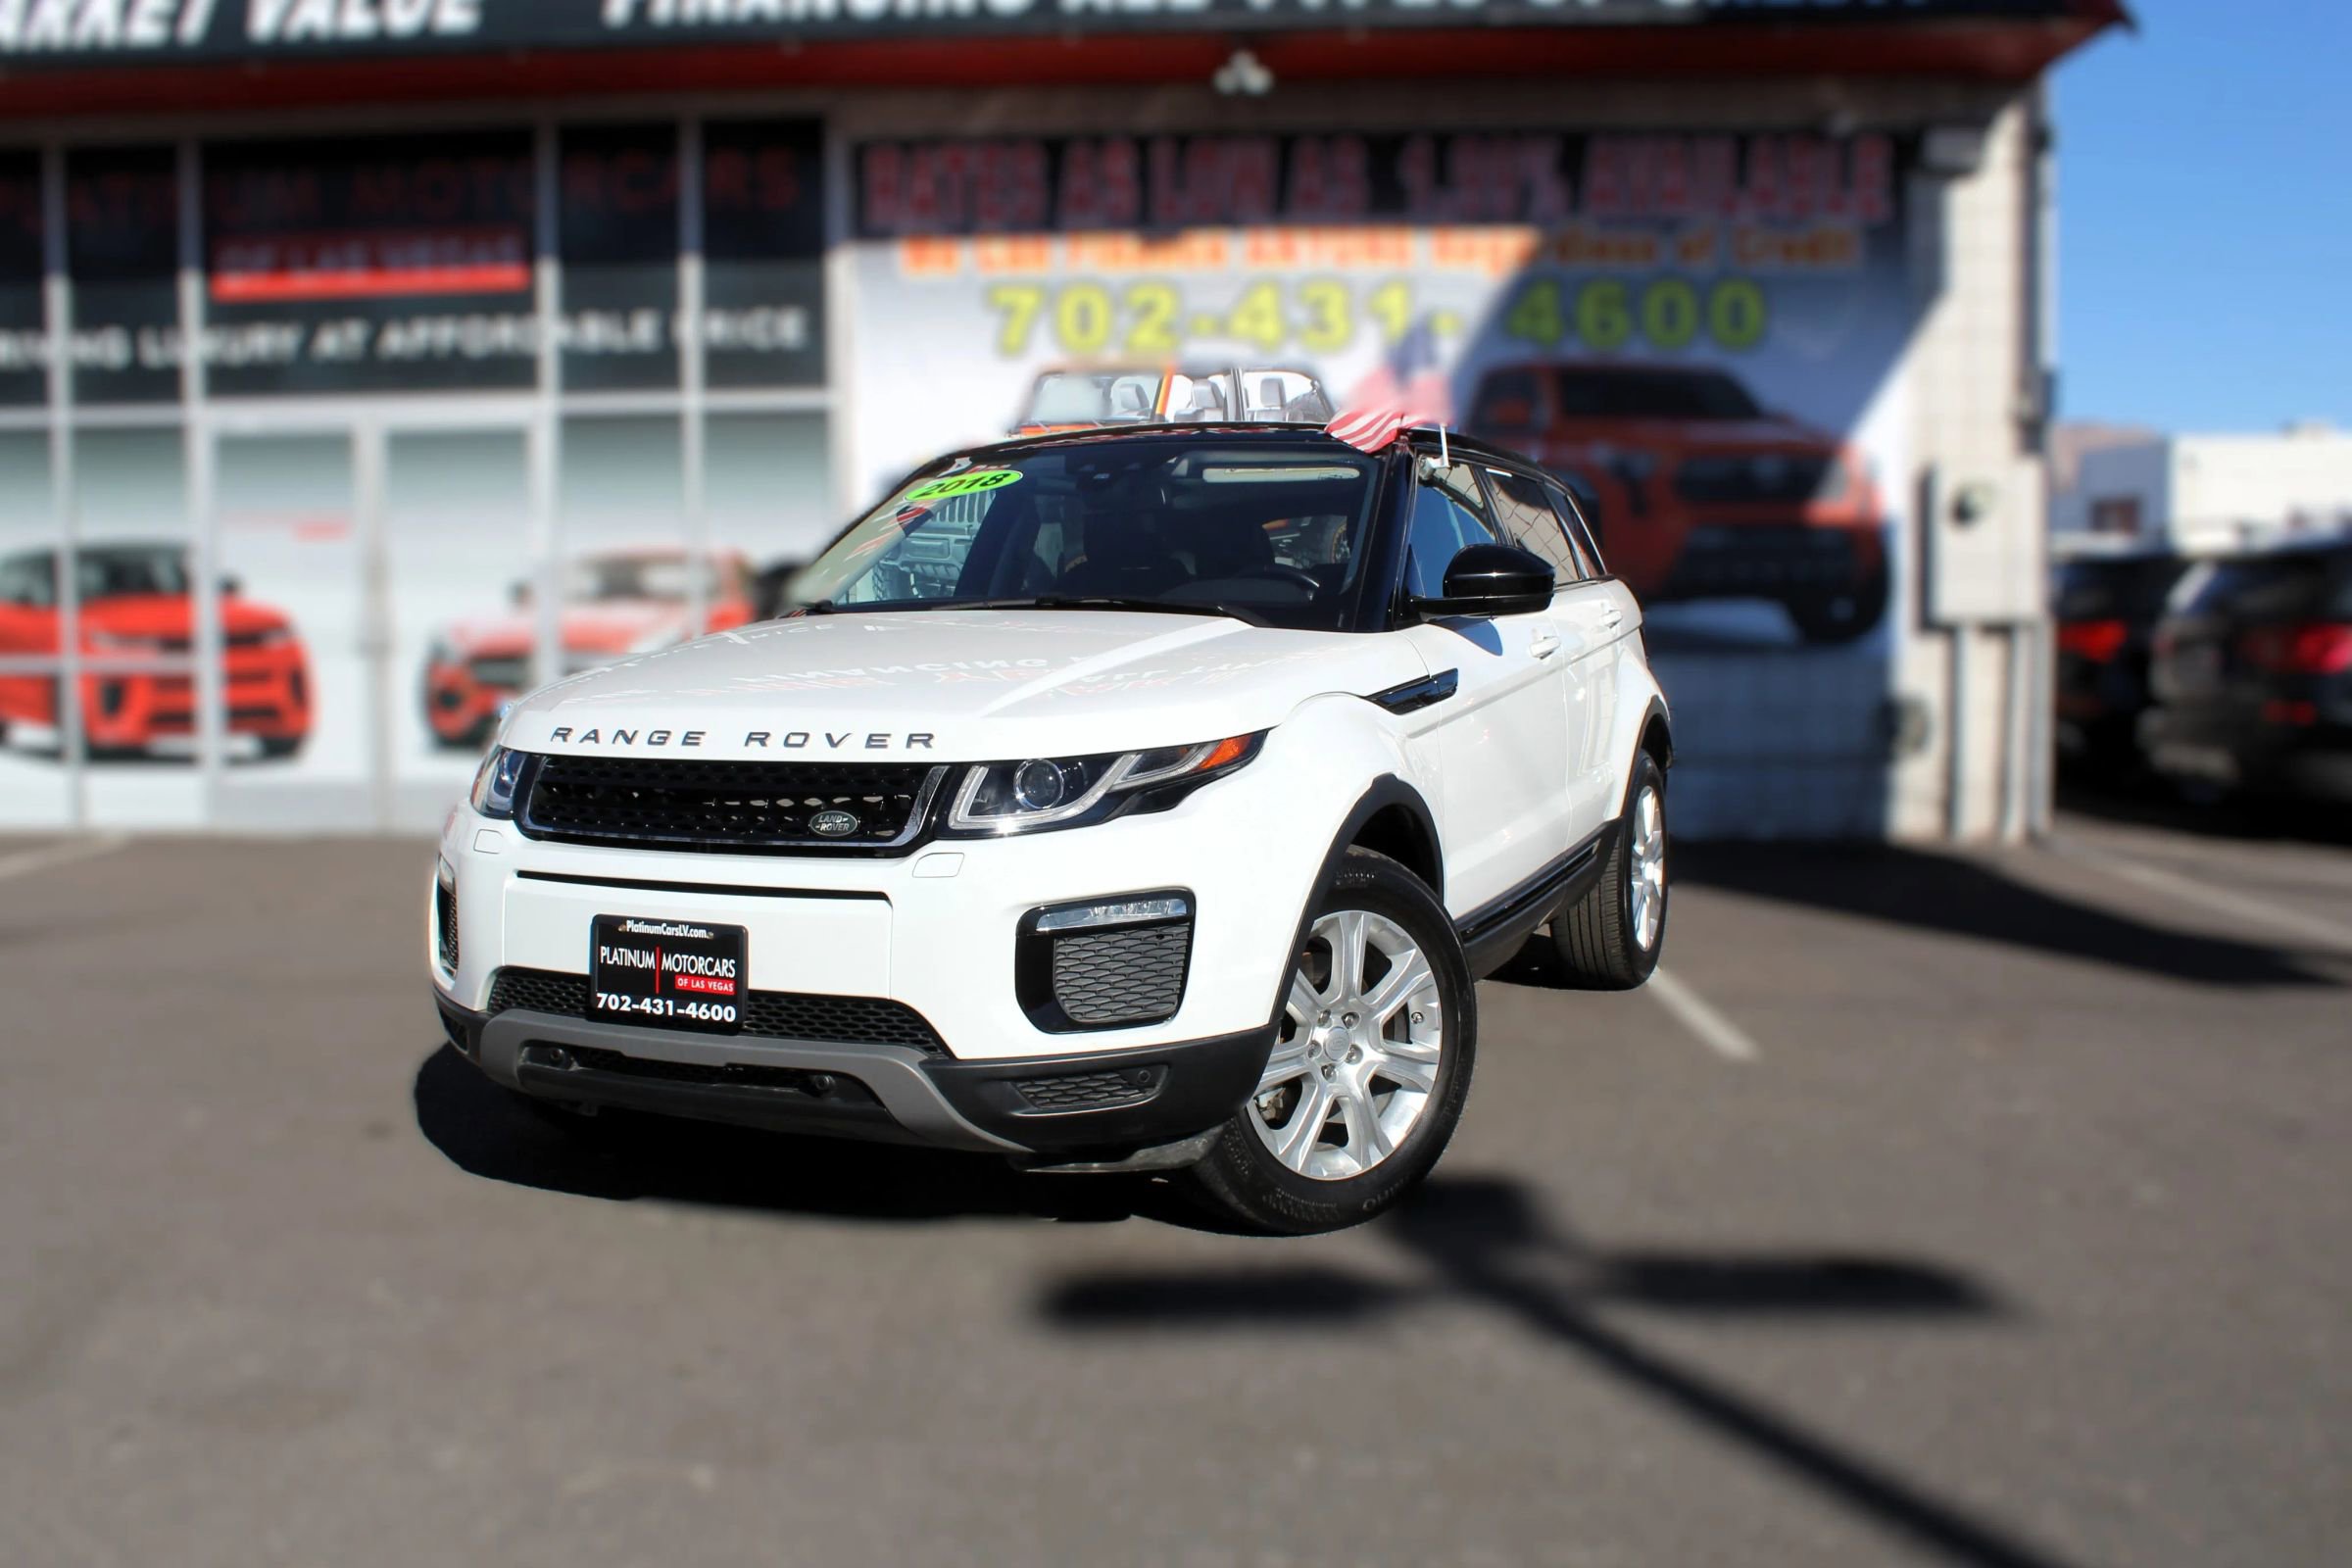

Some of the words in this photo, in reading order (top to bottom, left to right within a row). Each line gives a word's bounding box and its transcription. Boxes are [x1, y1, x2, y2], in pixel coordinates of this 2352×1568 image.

[913, 472, 1011, 499] 2018
[550, 726, 707, 747] RANGE
[743, 731, 935, 750] ROVER
[817, 814, 843, 823] LAND
[819, 822, 851, 832] ROVER
[600, 945, 656, 970] PLATINUM
[661, 953, 736, 979] MOTORCARS
[677, 978, 688, 987] OF
[691, 979, 705, 989] LAS
[708, 980, 734, 992] VEGAS
[596, 992, 736, 1023] 702-431-4600
